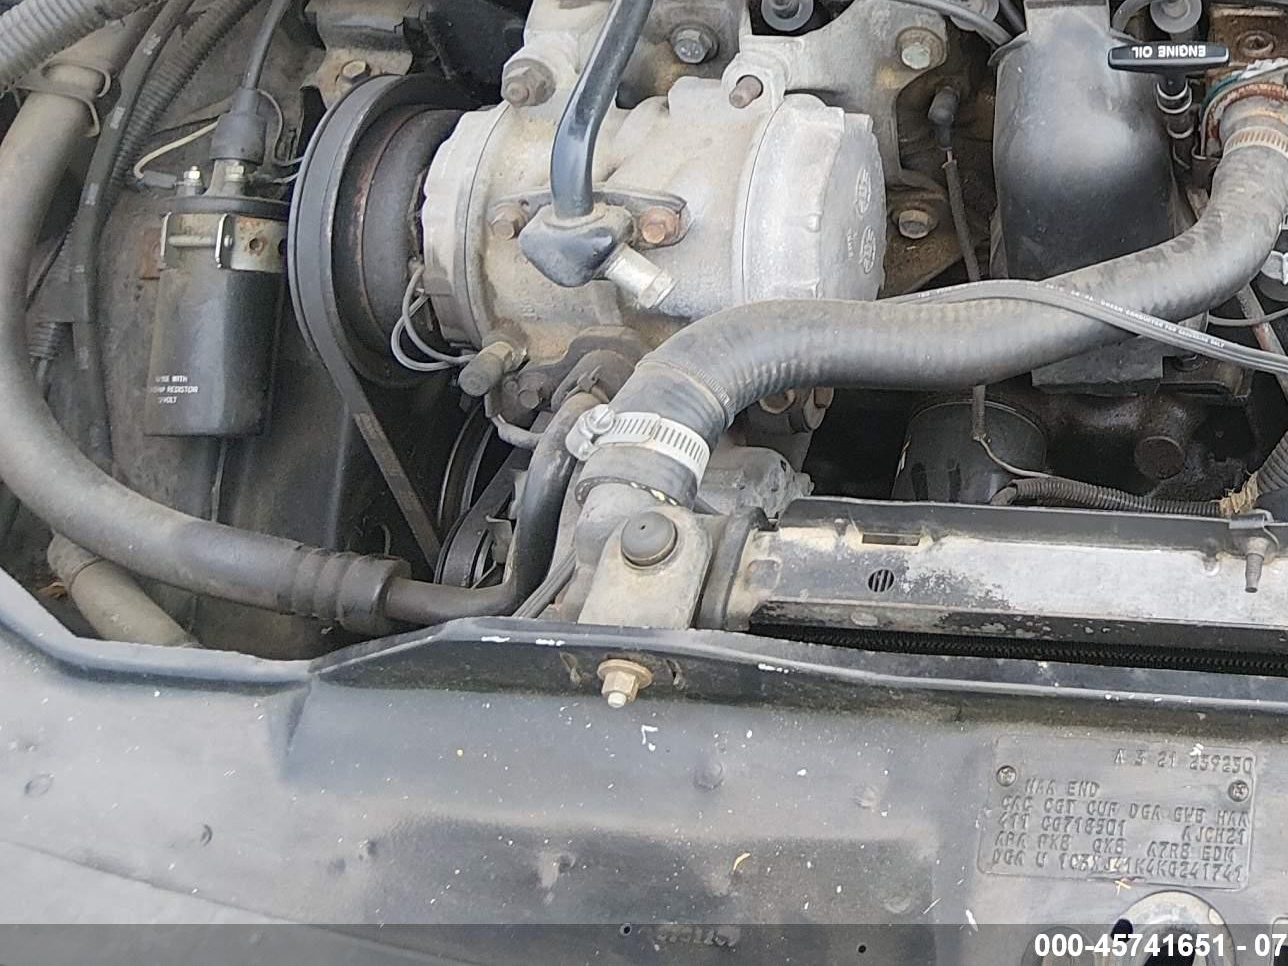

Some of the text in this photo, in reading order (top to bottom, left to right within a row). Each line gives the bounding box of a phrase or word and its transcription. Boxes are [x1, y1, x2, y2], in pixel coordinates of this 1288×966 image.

[1131, 45, 1206, 58] ENGINE OIL
[172, 375, 188, 383] WITH
